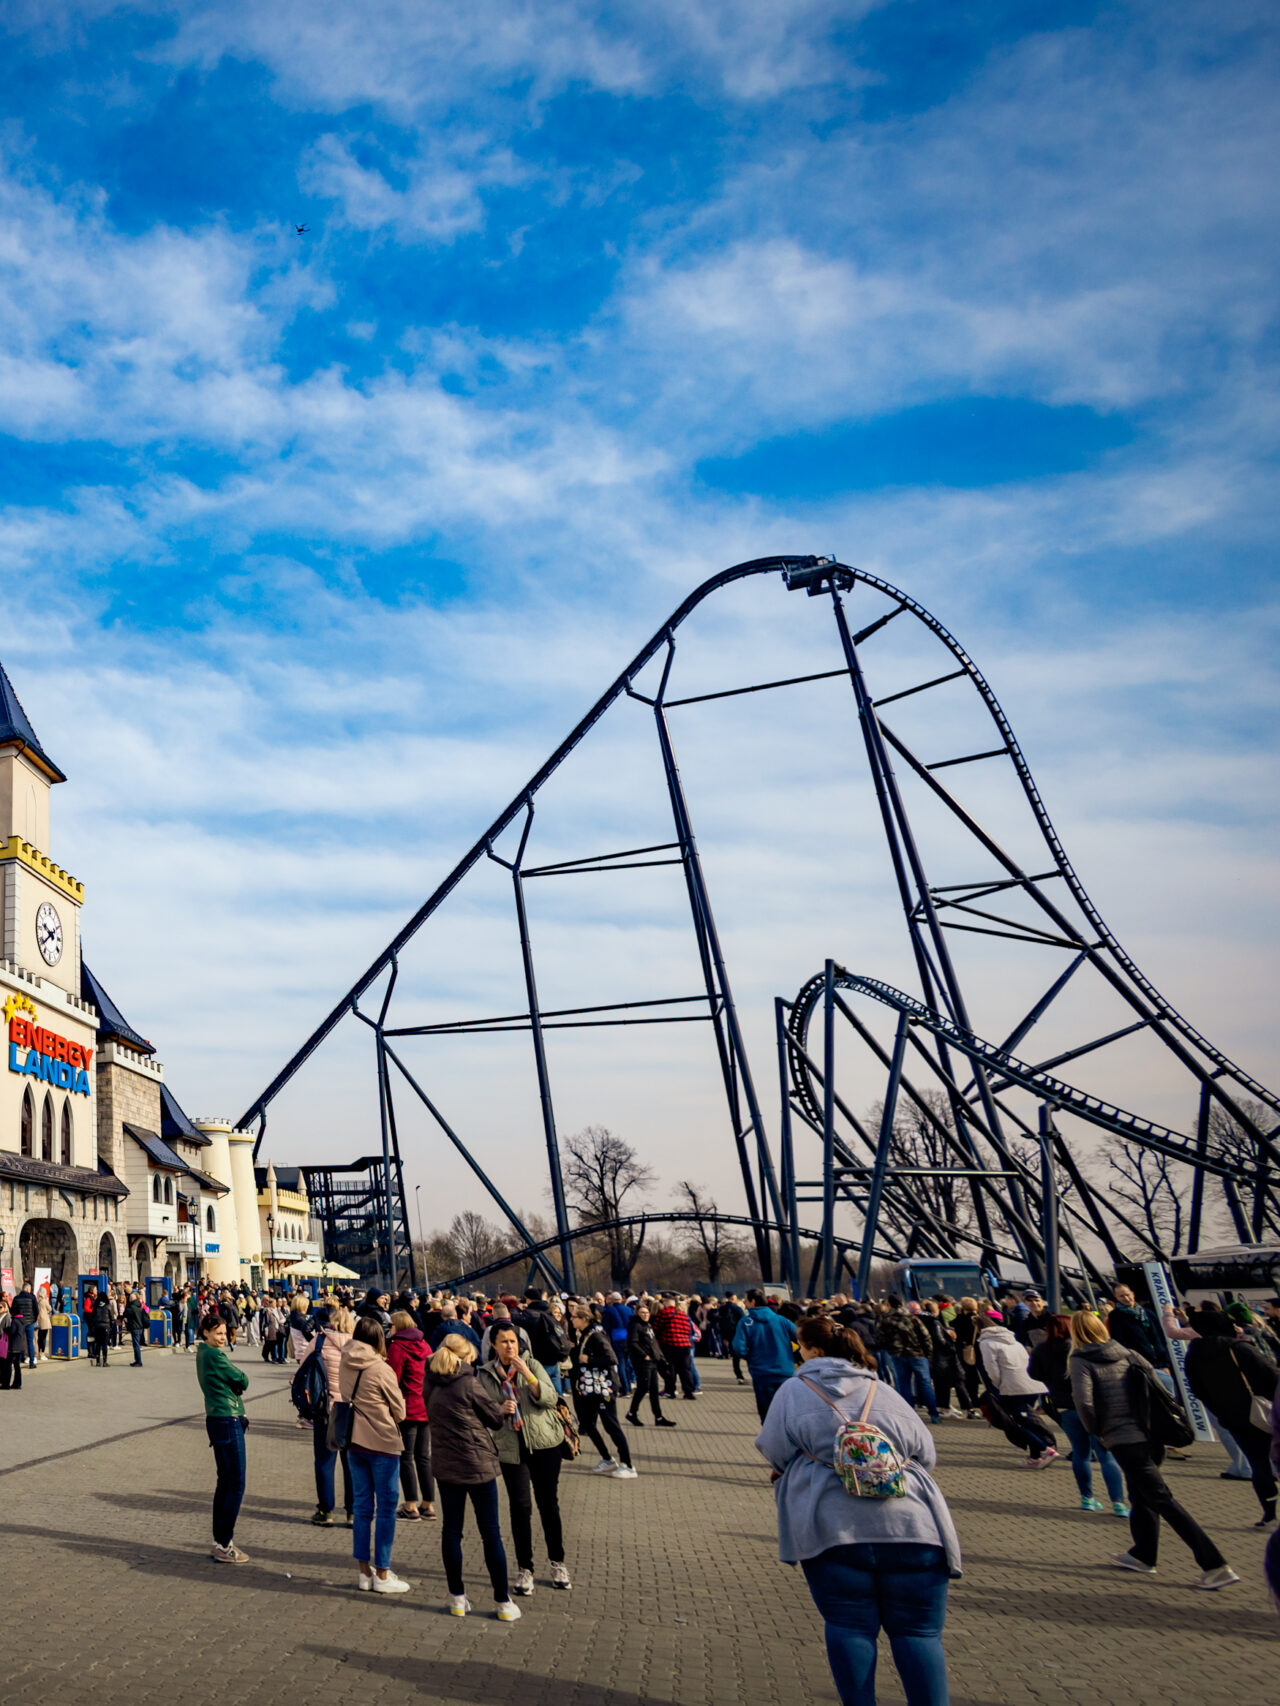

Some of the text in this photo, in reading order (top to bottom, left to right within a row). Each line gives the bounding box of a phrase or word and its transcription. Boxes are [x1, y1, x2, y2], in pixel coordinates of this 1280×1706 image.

[9, 1015, 93, 1071] ENERGY
[9, 1041, 91, 1097] LANDIA
[1151, 1271, 1170, 1306] KRAKÓ
